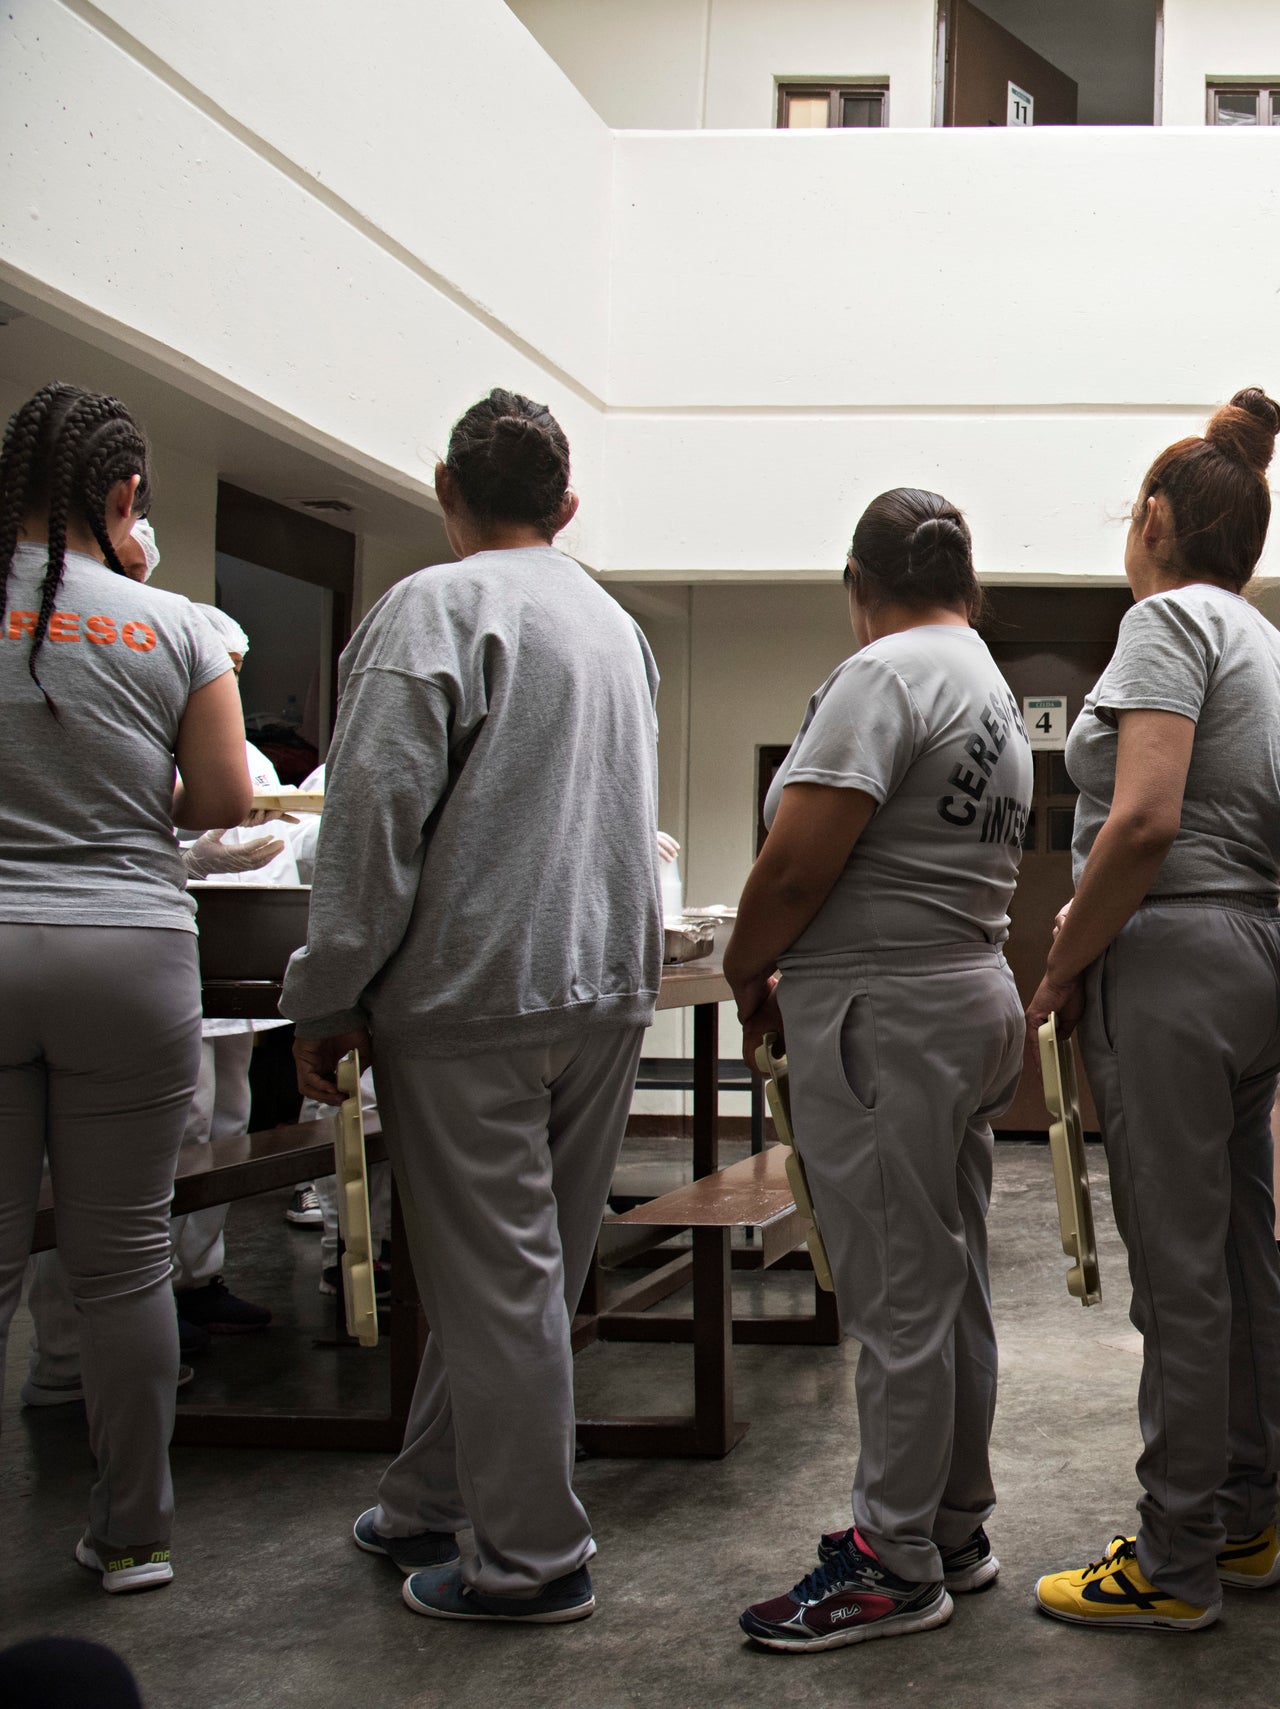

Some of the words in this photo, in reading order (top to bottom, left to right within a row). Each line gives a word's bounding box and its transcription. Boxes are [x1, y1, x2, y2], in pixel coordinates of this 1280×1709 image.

[1013, 101, 1027, 125] 11
[0, 610, 157, 652] RESO
[1035, 711, 1052, 733] 4
[108, 1557, 134, 1572] AIR
[830, 1603, 862, 1624] FILA
